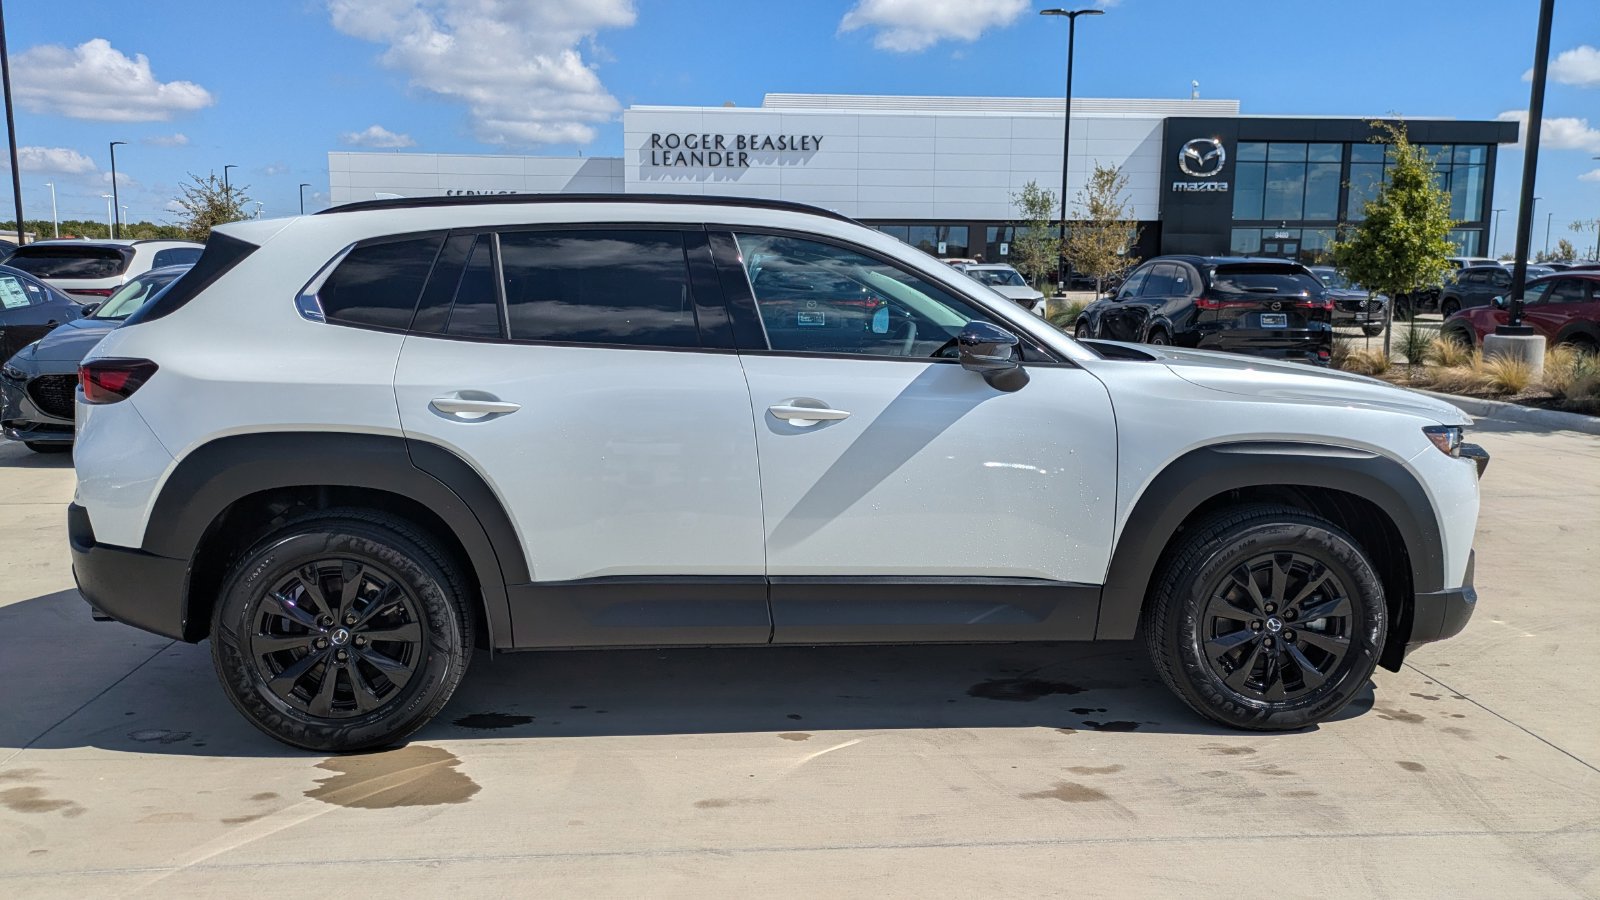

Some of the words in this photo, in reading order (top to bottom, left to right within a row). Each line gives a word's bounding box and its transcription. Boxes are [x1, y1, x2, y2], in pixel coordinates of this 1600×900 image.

[651, 133, 726, 149] ROGER
[736, 134, 823, 150] BEASLEY
[651, 151, 750, 168] LEANDER
[1172, 181, 1229, 192] mazda
